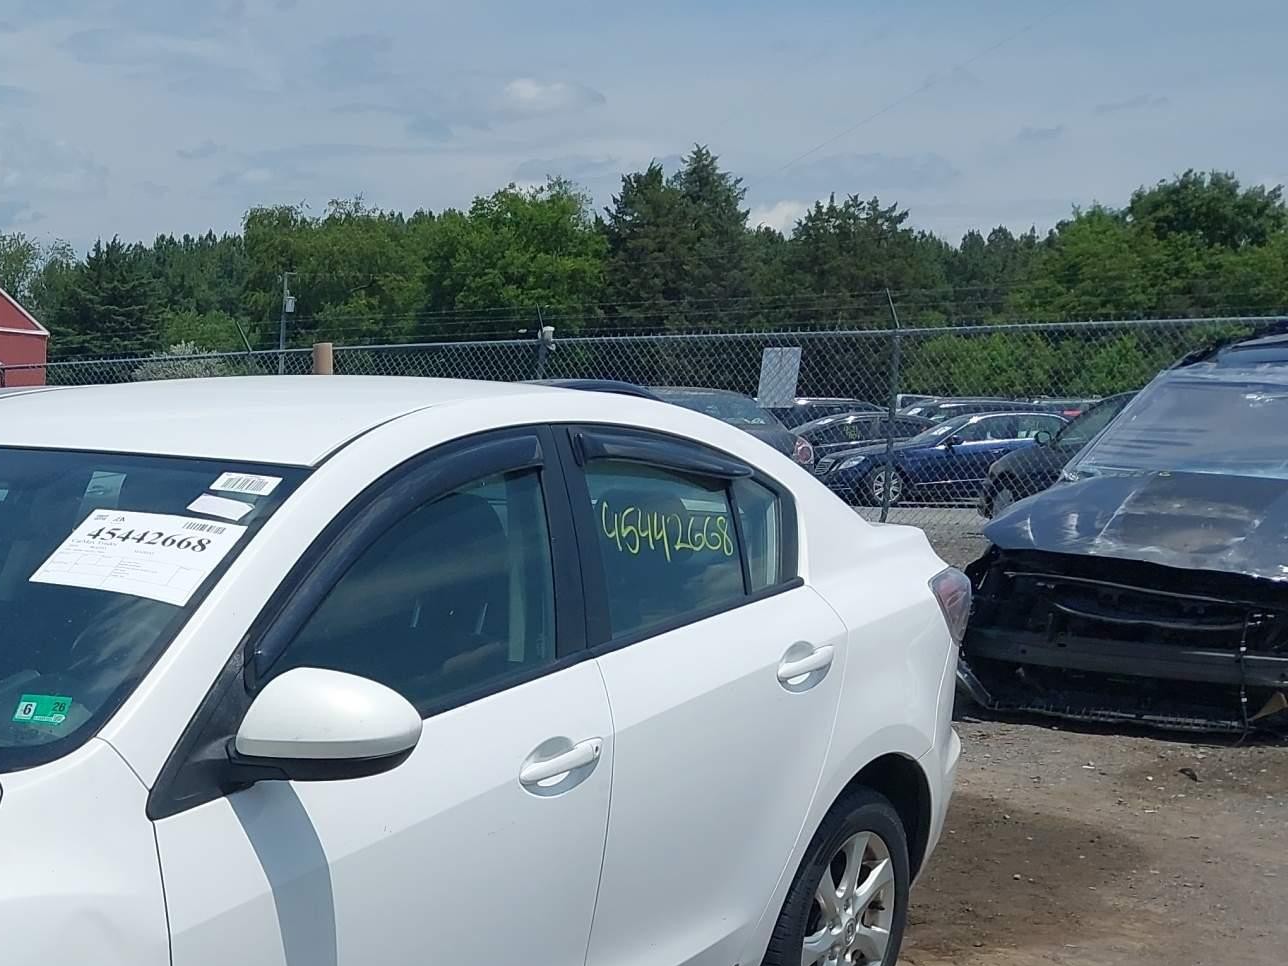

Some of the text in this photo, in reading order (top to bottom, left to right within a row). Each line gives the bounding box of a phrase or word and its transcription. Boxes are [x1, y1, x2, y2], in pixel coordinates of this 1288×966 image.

[86, 526, 212, 553] 45442668
[601, 501, 734, 563] 45442668
[23, 703, 33, 716] 6
